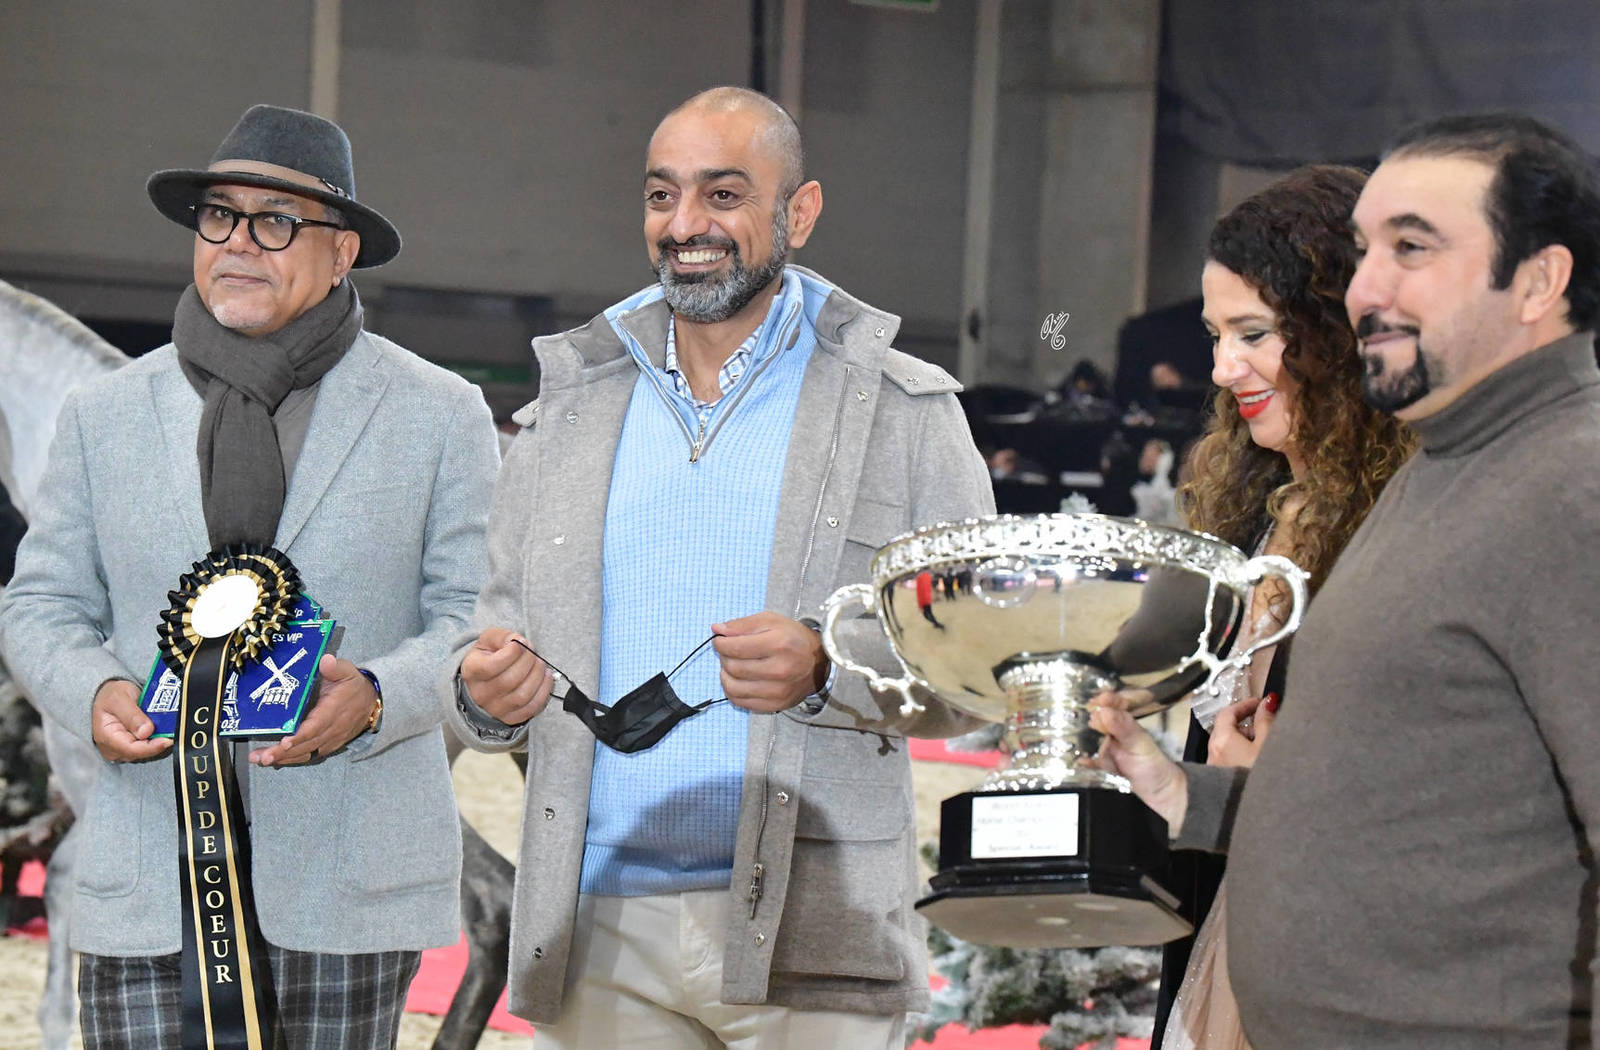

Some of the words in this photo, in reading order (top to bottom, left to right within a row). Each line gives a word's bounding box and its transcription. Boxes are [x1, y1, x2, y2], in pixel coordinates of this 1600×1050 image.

[287, 632, 304, 643] VIP
[220, 719, 241, 729] 021
[190, 706, 210, 799] COUP
[199, 810, 217, 855] DE
[203, 865, 233, 985] COEUR
